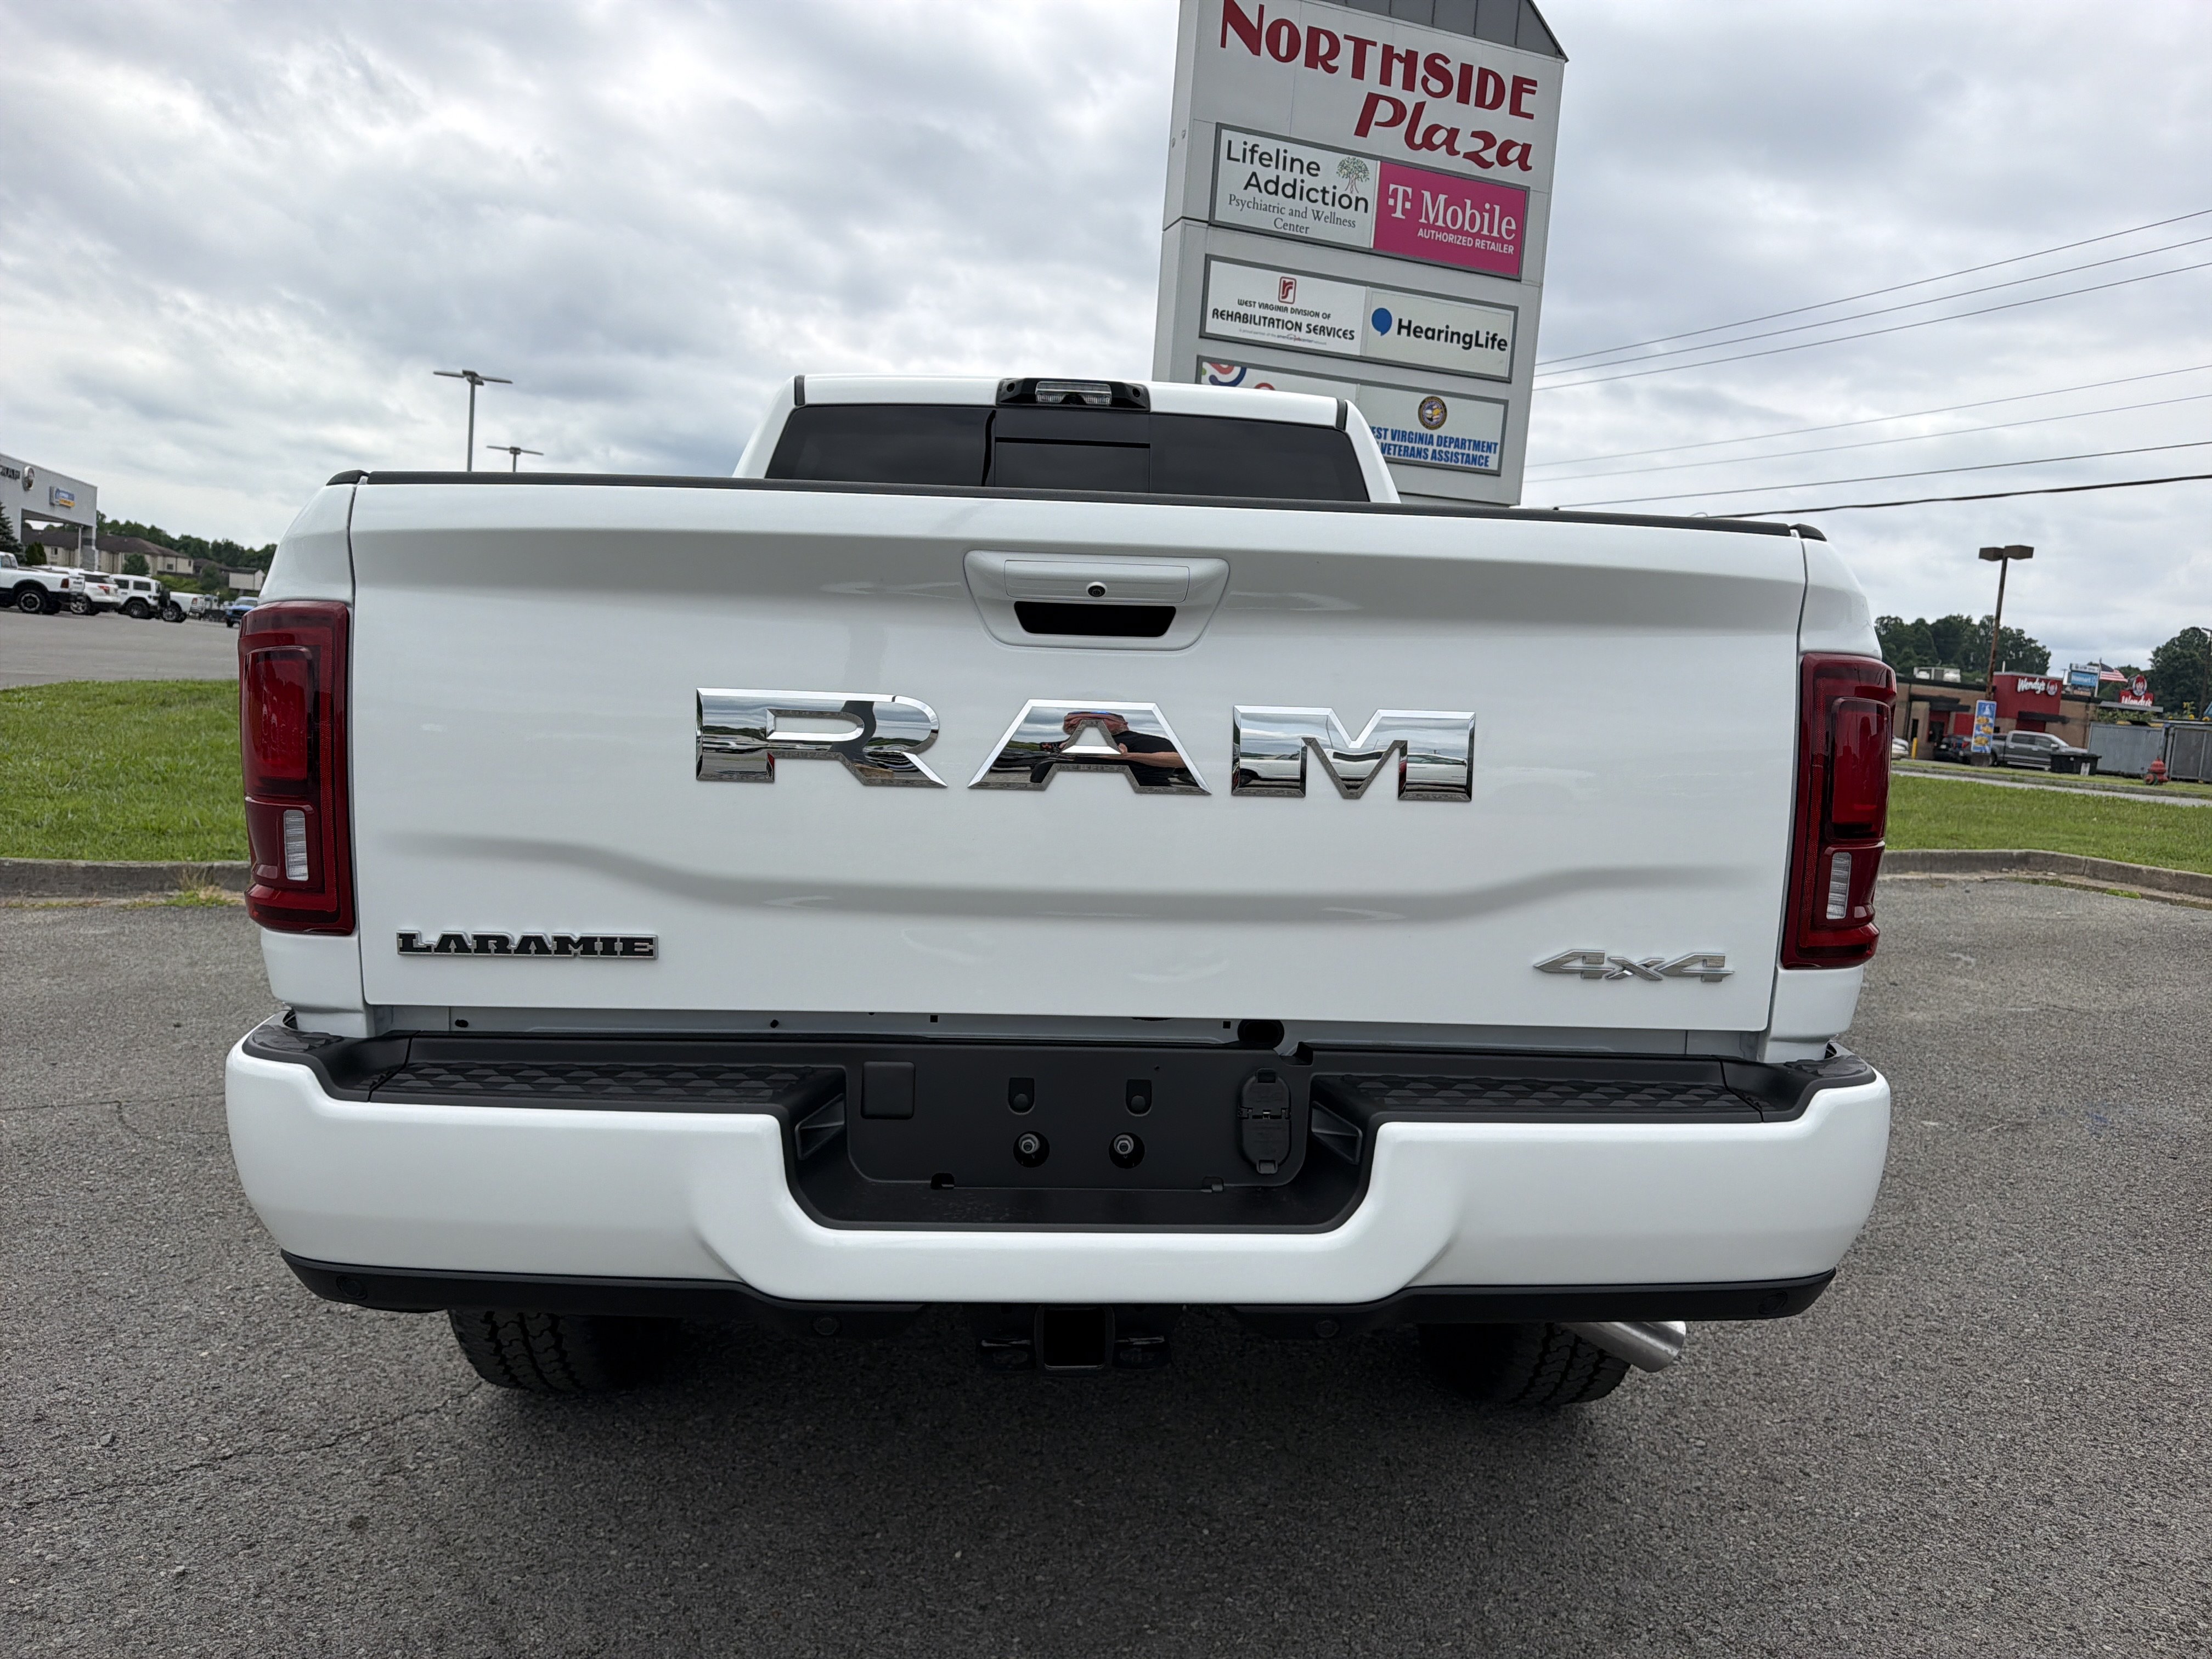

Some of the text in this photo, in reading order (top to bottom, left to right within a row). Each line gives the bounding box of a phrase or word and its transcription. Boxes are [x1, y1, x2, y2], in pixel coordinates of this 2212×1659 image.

[1221, 0, 1538, 120] NORTHSIDE
[1353, 92, 1532, 172] Plaza
[1227, 140, 1321, 177] Lifeline
[1243, 171, 1368, 213] Addiction
[1229, 194, 1356, 228] Psychiatric and Wellness
[1274, 218, 1310, 234] Center
[1418, 190, 1516, 240] Mobile
[1417, 228, 1514, 255] AUTHORIZED RETAILER
[1212, 308, 1302, 332] REHABILITATION
[1305, 323, 1355, 341] SERVICES
[1237, 298, 1256, 308] WEST
[1258, 302, 1288, 313] VIRGINIA
[1290, 307, 1319, 318] DIVISION
[1397, 318, 1508, 352] HearingLife
[1369, 426, 1389, 440] EST
[1390, 428, 1434, 447] VIRGINIA
[1437, 435, 1498, 454] DEPARTMENT
[1380, 442, 1429, 460] VETERANS
[1430, 449, 1489, 467] ASSISTANCE
[2017, 677, 2046, 695] Wendy's
[696, 687, 1476, 802] RAM
[397, 930, 658, 960] LARAMIE
